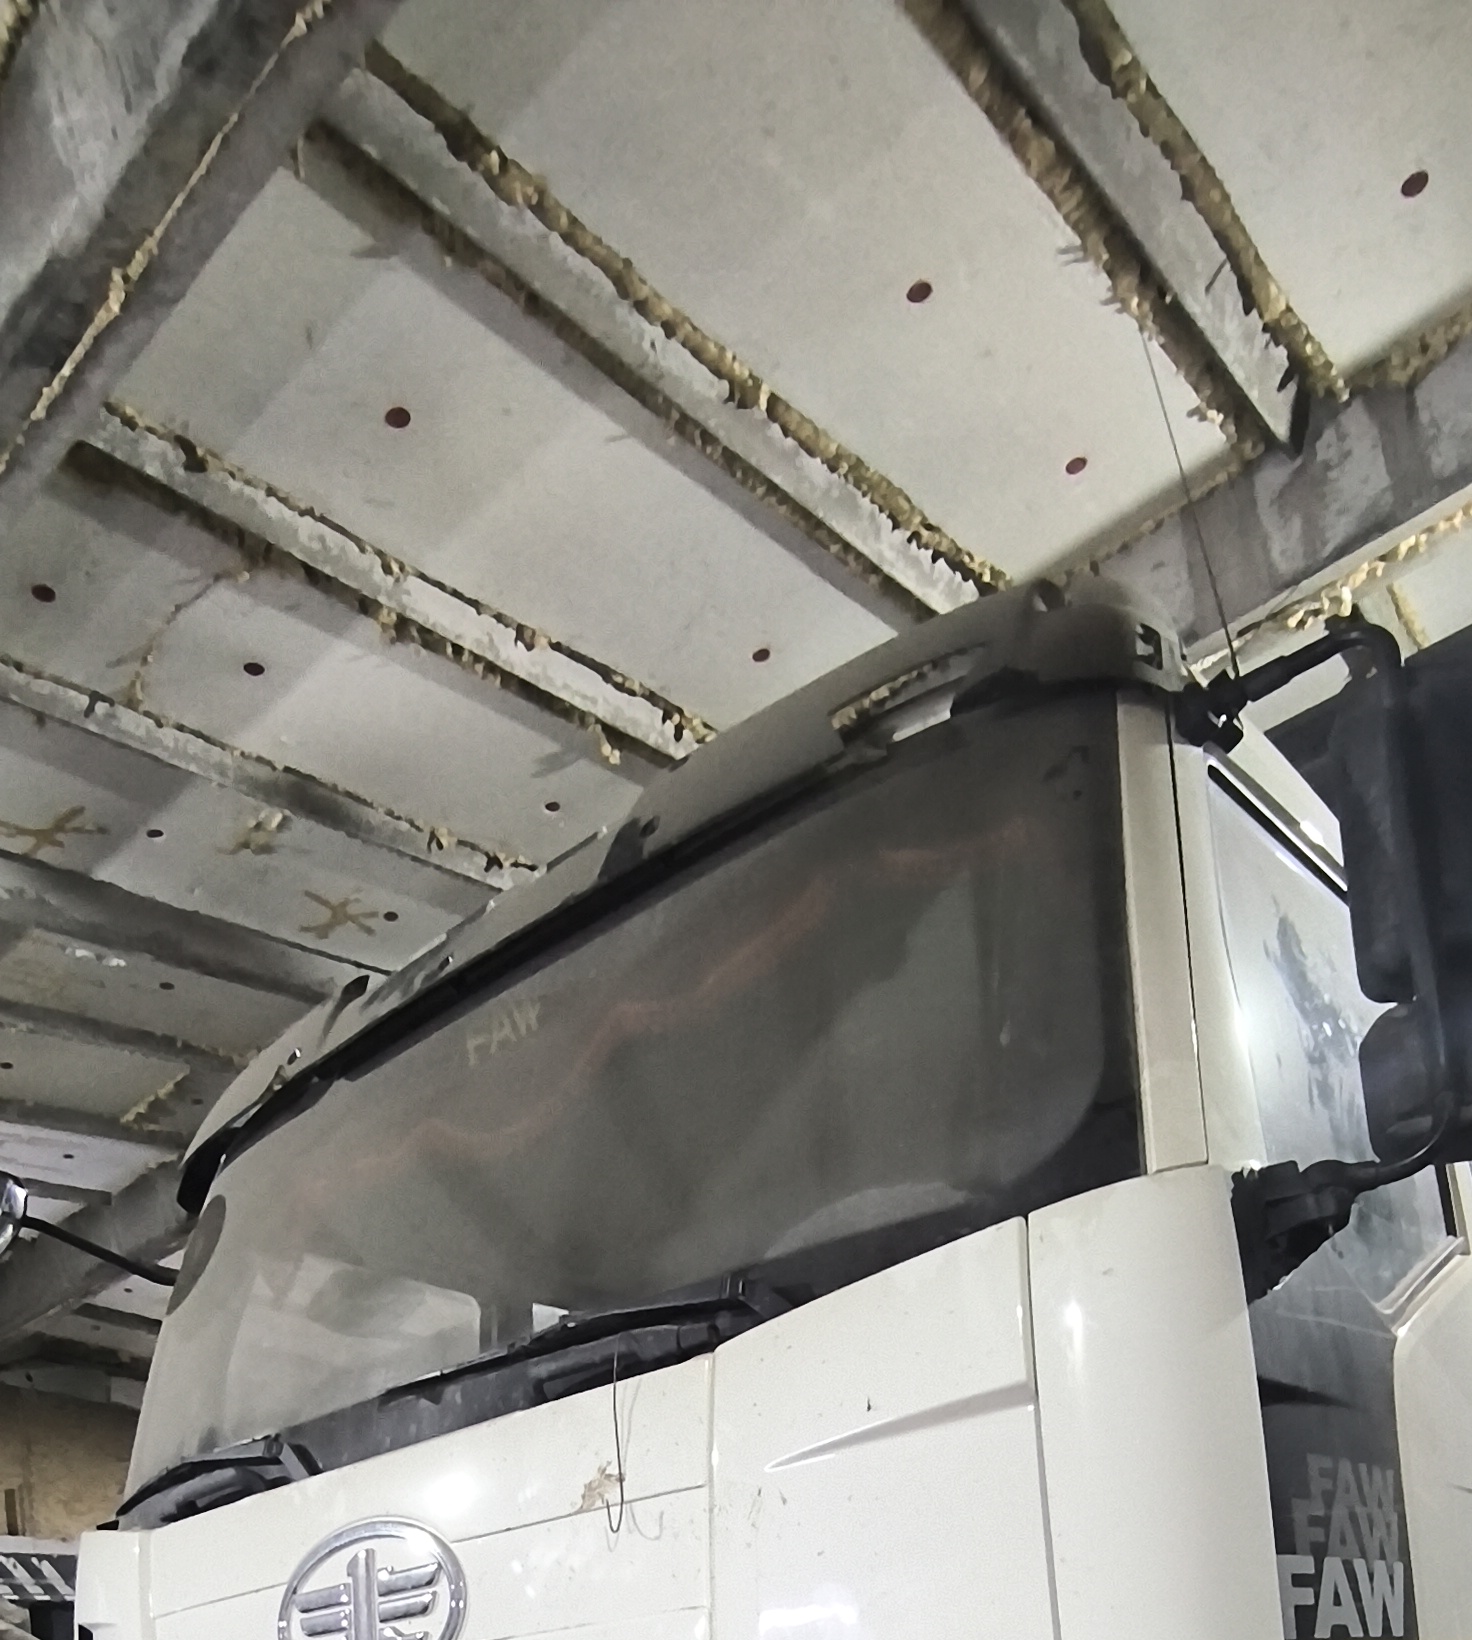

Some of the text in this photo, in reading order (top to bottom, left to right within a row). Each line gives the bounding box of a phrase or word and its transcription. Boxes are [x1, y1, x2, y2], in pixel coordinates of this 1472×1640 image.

[466, 1000, 541, 1066] FAW
[1307, 1453, 1395, 1505] FAW
[1291, 1497, 1399, 1572] FAW
[1277, 1554, 1404, 1640] FAW
